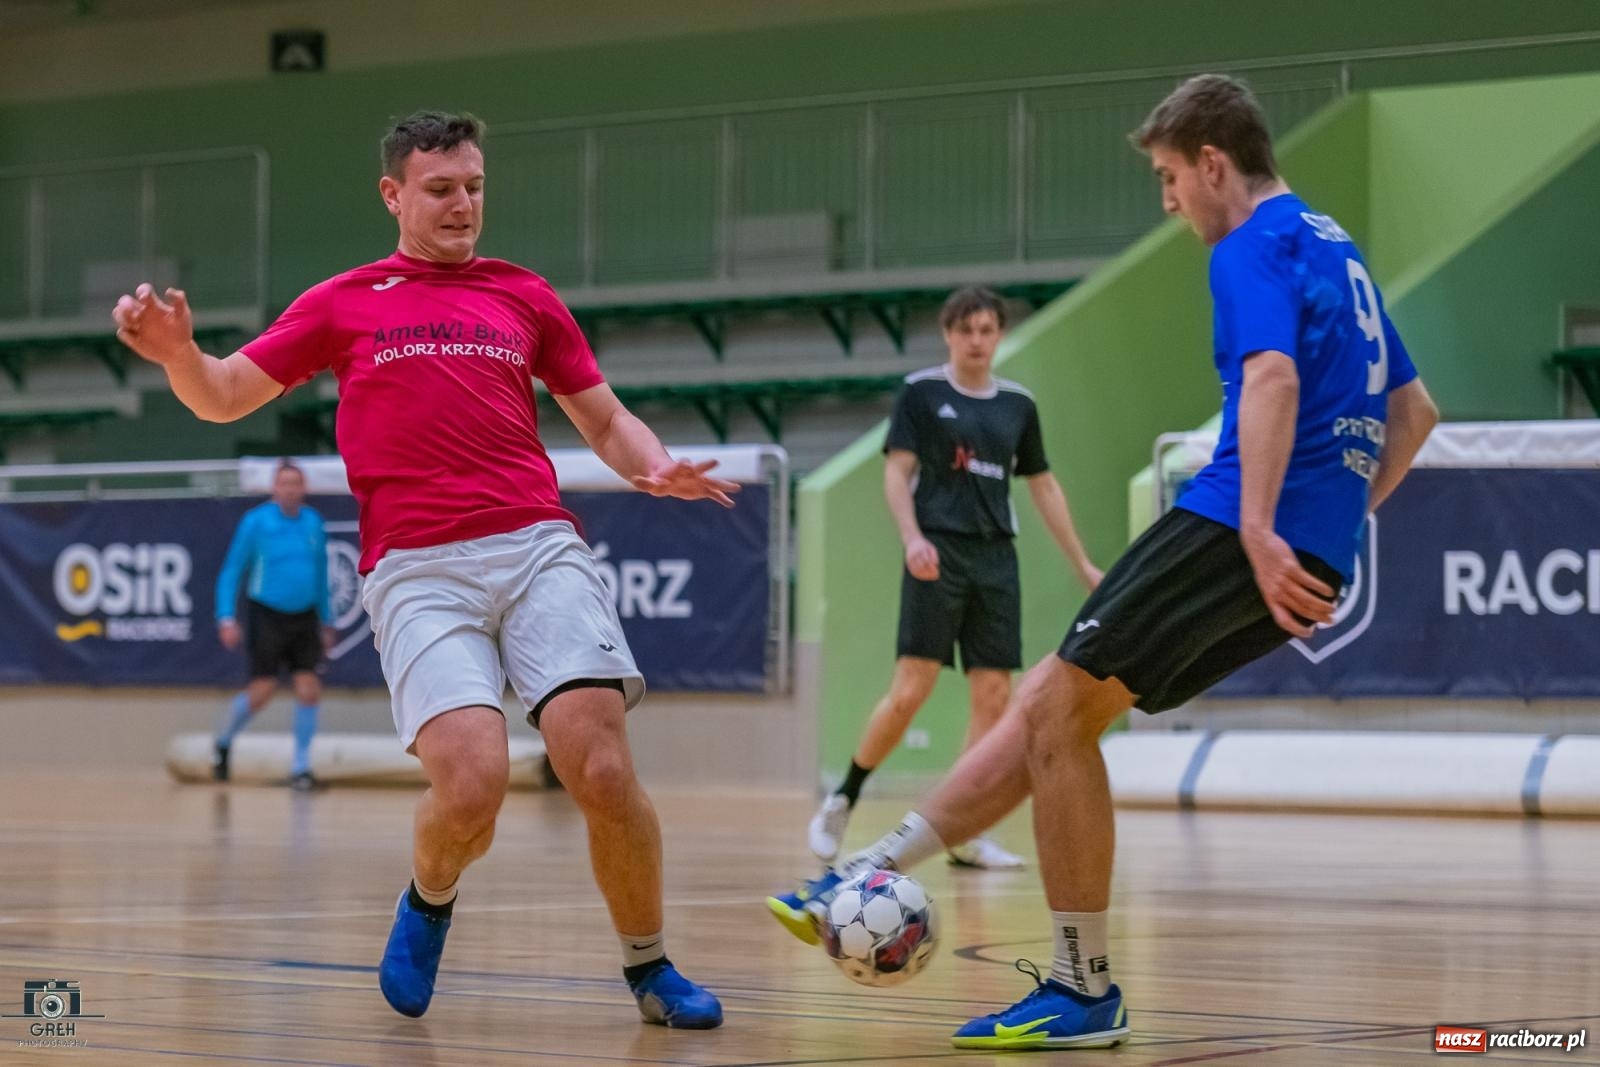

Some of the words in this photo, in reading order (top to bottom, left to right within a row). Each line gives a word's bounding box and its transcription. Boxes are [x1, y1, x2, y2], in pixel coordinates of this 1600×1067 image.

[373, 343, 438, 367] KOLORZ
[1346, 257, 1389, 395] 9
[53, 542, 193, 616] OSiR
